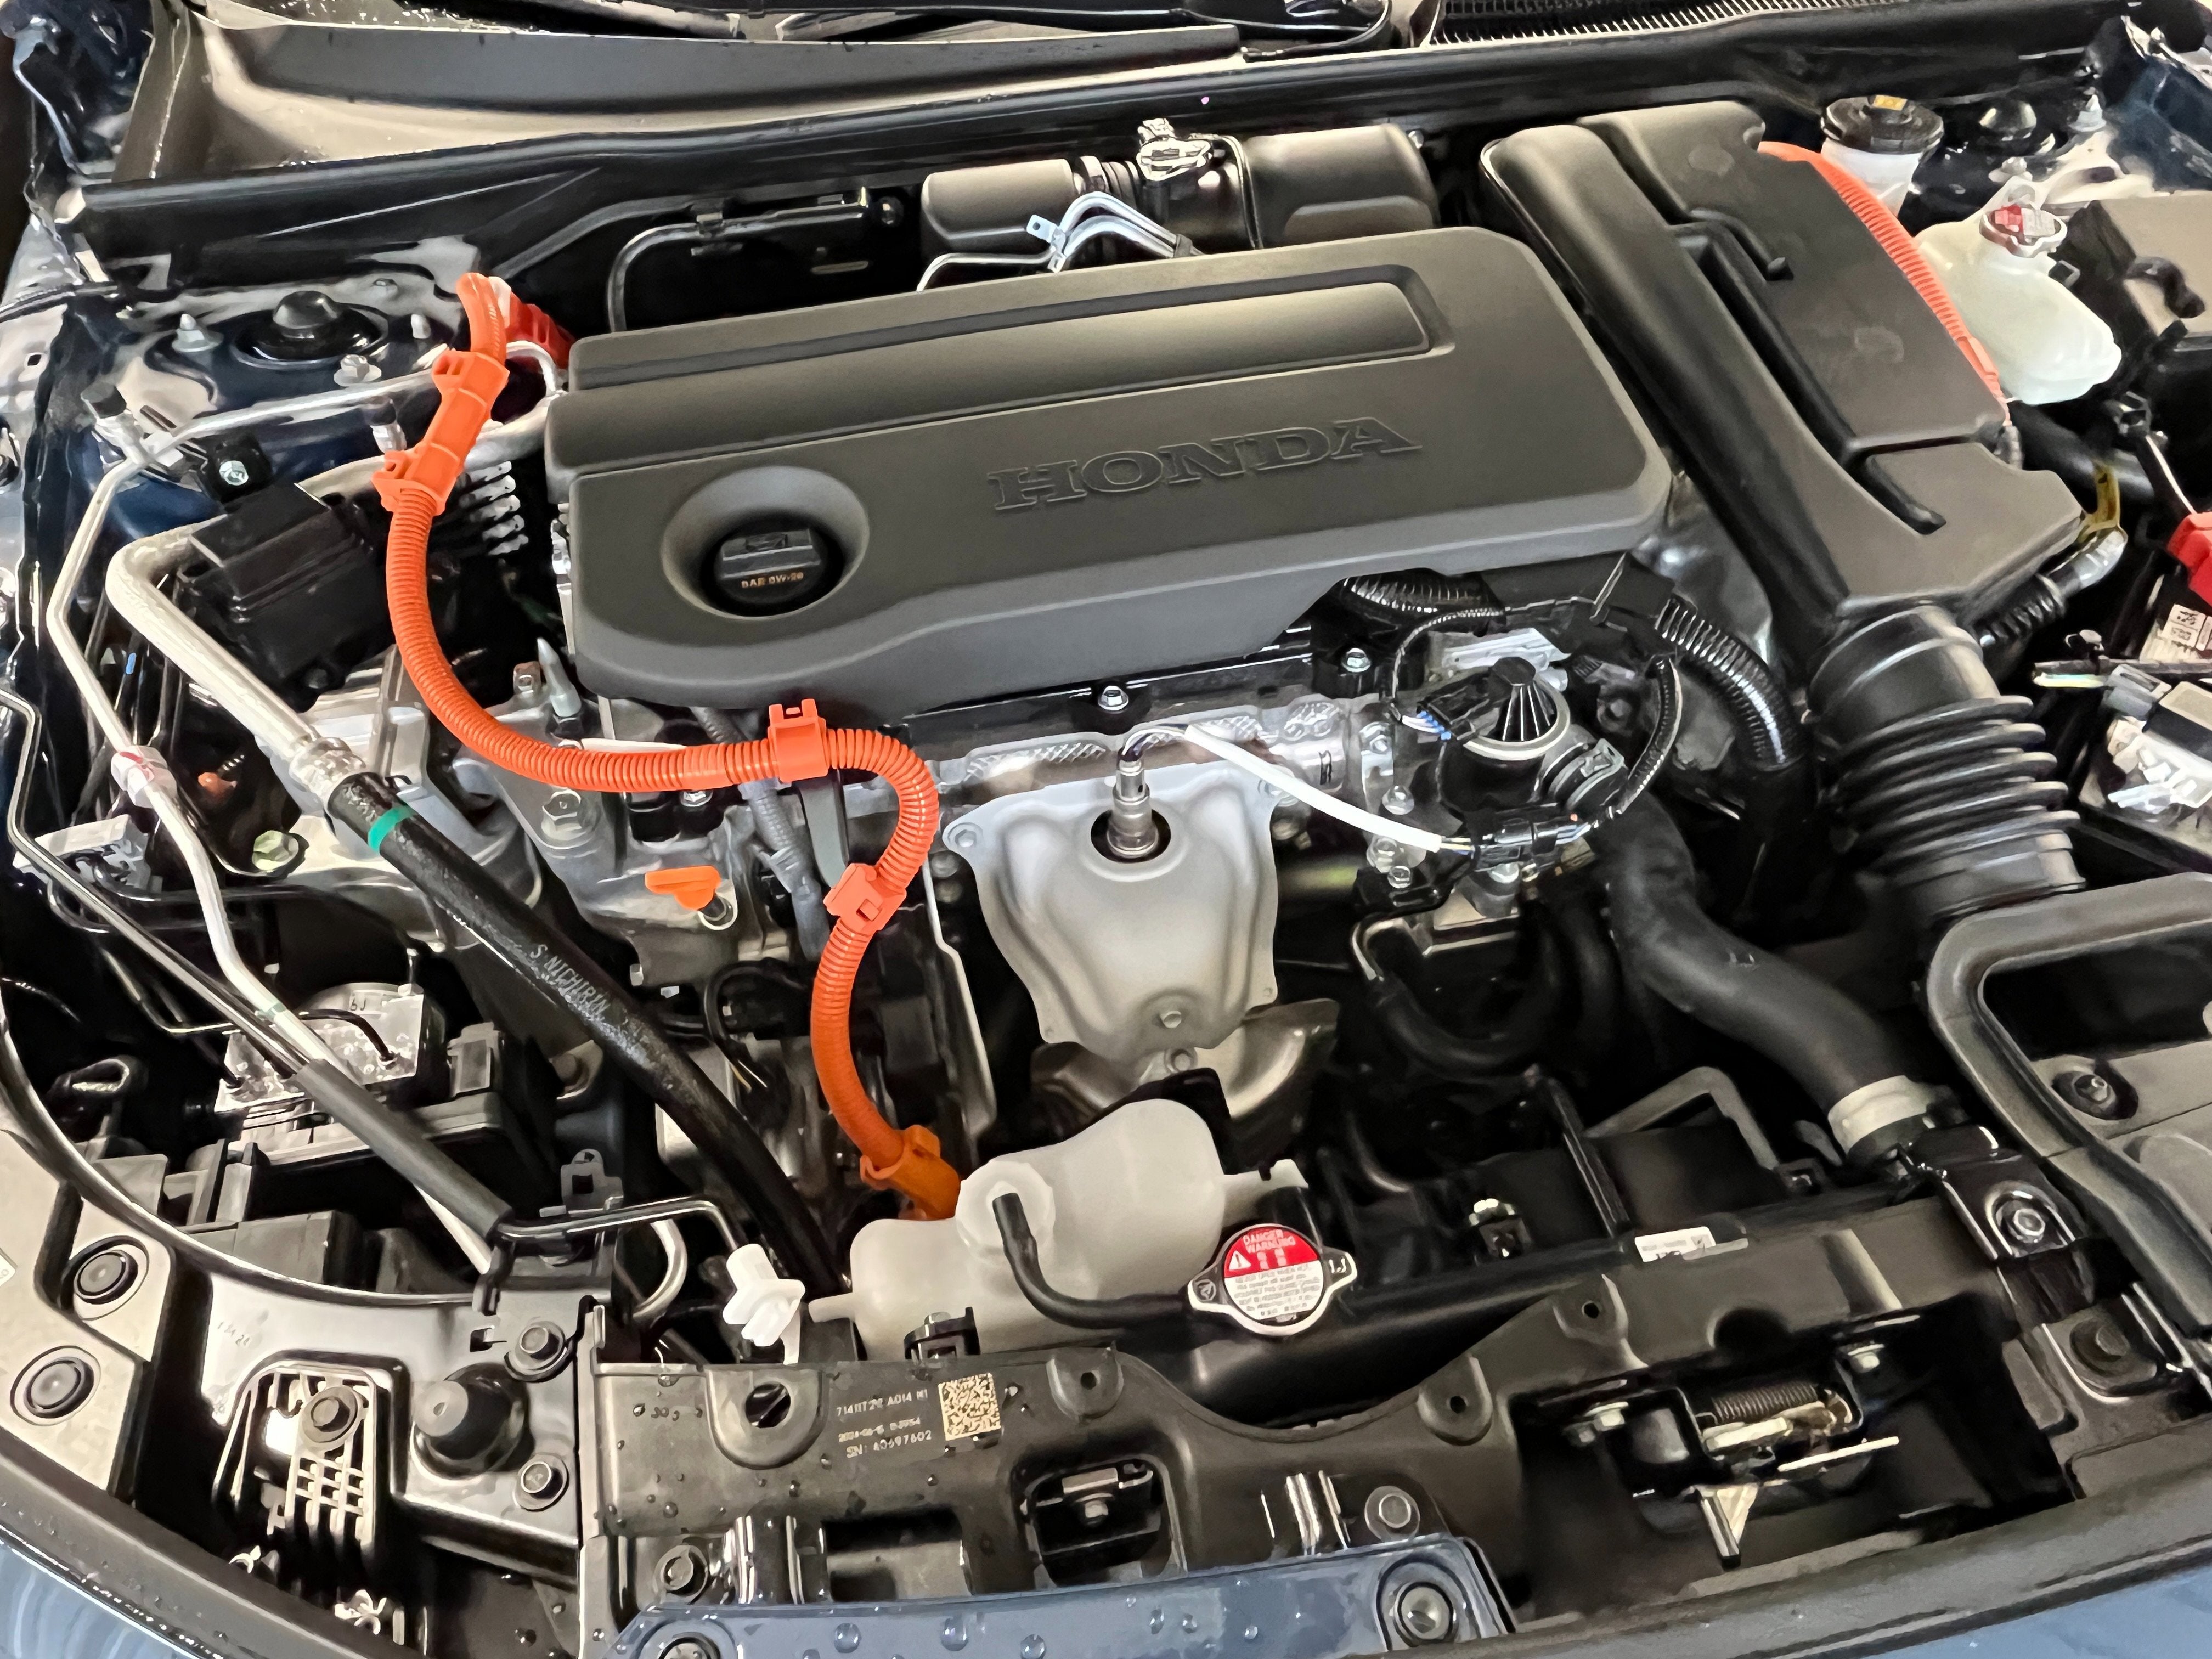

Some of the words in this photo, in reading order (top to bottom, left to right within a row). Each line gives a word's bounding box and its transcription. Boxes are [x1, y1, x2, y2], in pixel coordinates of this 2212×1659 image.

[986, 415, 1423, 511] HONDA
[1242, 1229, 1284, 1245] DANGER
[1246, 1235, 1296, 1254] WARNING
